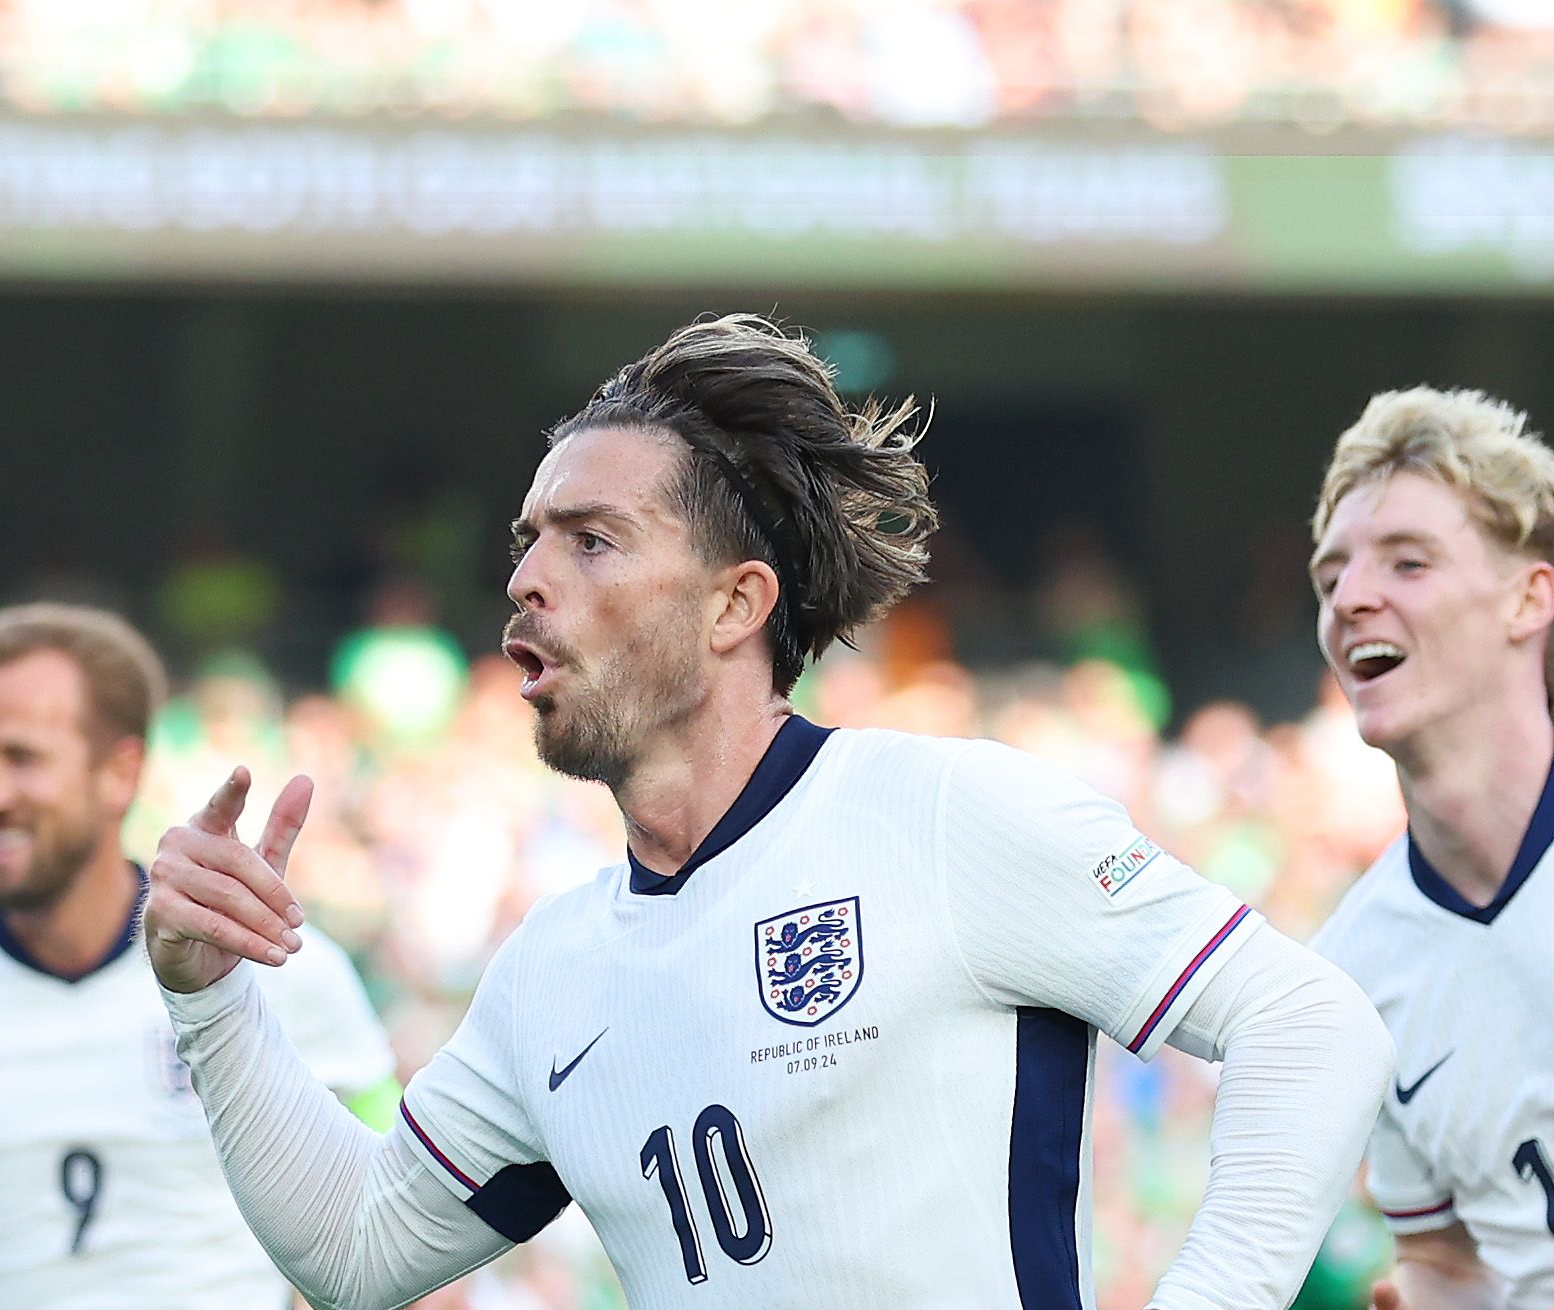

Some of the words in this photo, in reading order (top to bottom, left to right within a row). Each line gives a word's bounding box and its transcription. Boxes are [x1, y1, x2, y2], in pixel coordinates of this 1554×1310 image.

[1092, 854, 1118, 879] UEFA
[750, 1041, 803, 1064] REPUBLIC
[806, 1036, 820, 1050] OF
[824, 1026, 879, 1048] IRELAND
[787, 1053, 837, 1075] 07.09.24
[59, 1147, 104, 1256] 9
[640, 1104, 773, 1286] 10
